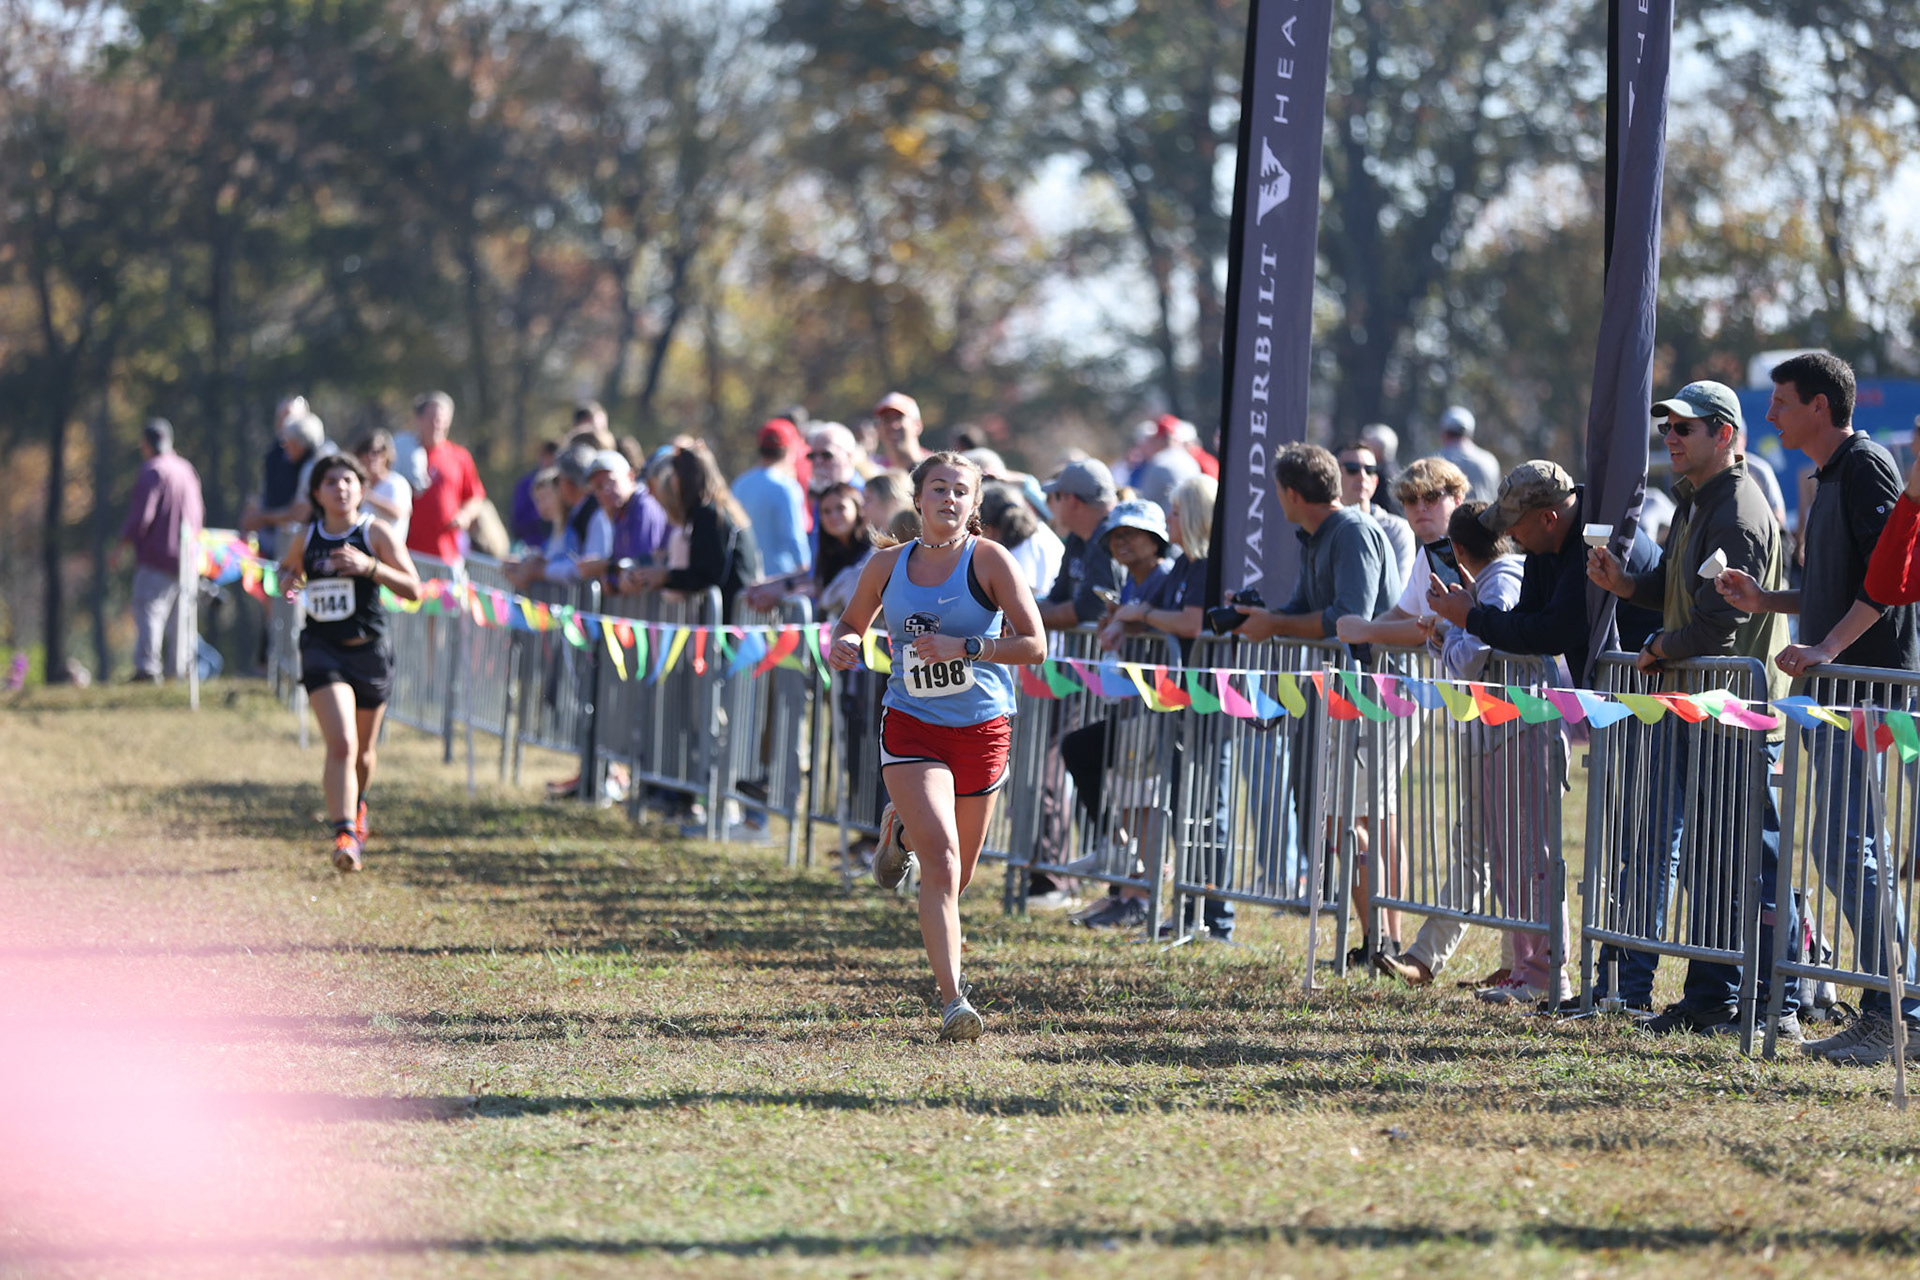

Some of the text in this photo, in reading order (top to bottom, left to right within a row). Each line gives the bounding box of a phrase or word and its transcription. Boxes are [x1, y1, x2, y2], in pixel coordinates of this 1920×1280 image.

[1273, 0, 1298, 124] HEA
[1242, 243, 1277, 589] VANDERBILT
[313, 595, 348, 613] 1144
[910, 660, 966, 689] 1198
